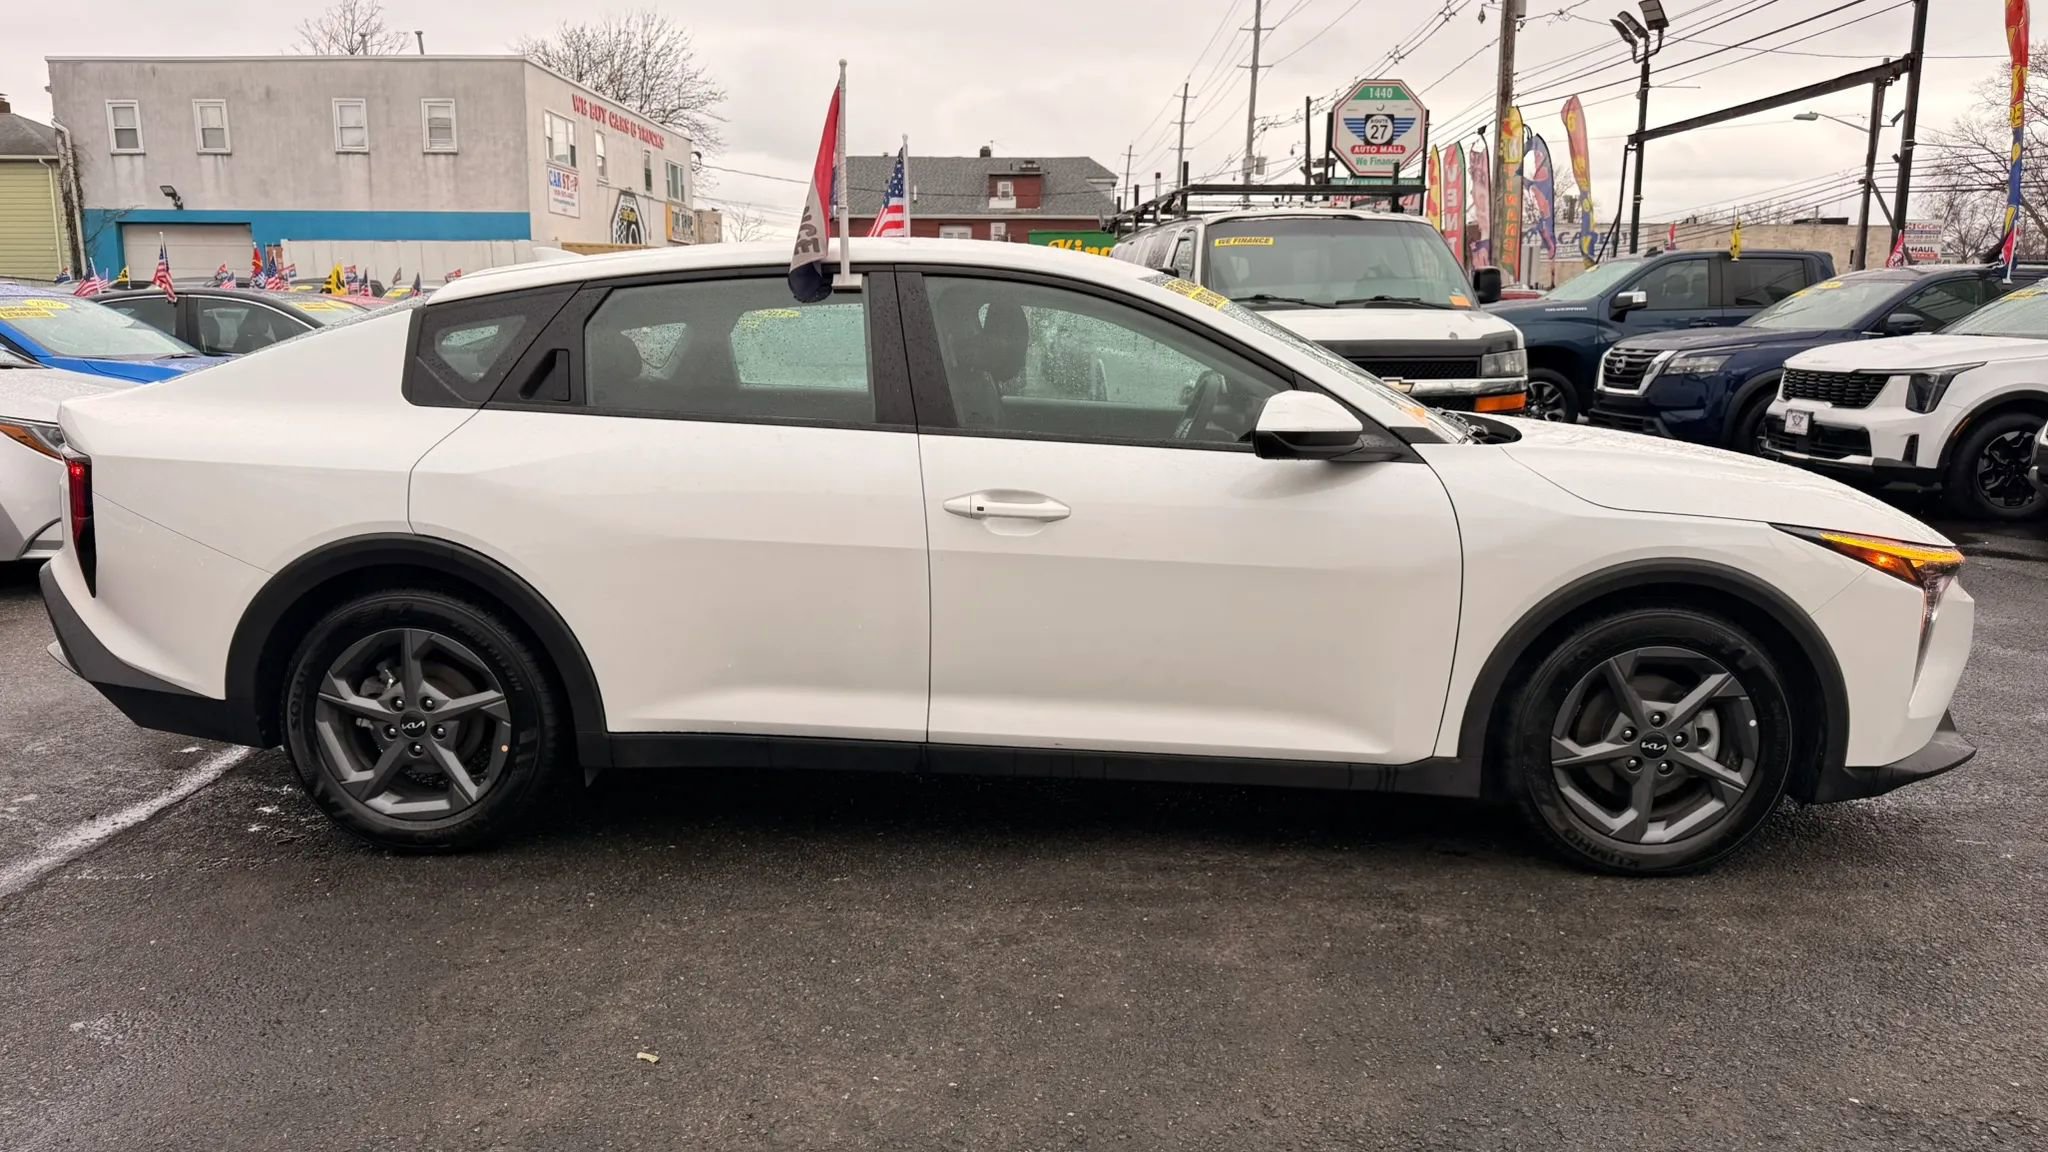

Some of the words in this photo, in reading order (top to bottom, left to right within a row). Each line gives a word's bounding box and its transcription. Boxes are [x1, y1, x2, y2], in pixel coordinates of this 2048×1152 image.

[1369, 87, 1393, 99] 1440
[1370, 124, 1389, 140] 27
[1353, 146, 1379, 154] AUTO
[1379, 146, 1404, 154] MALL
[1356, 157, 1367, 166] We
[549, 169, 562, 188] CAR
[1232, 237, 1271, 245] FINANCE
